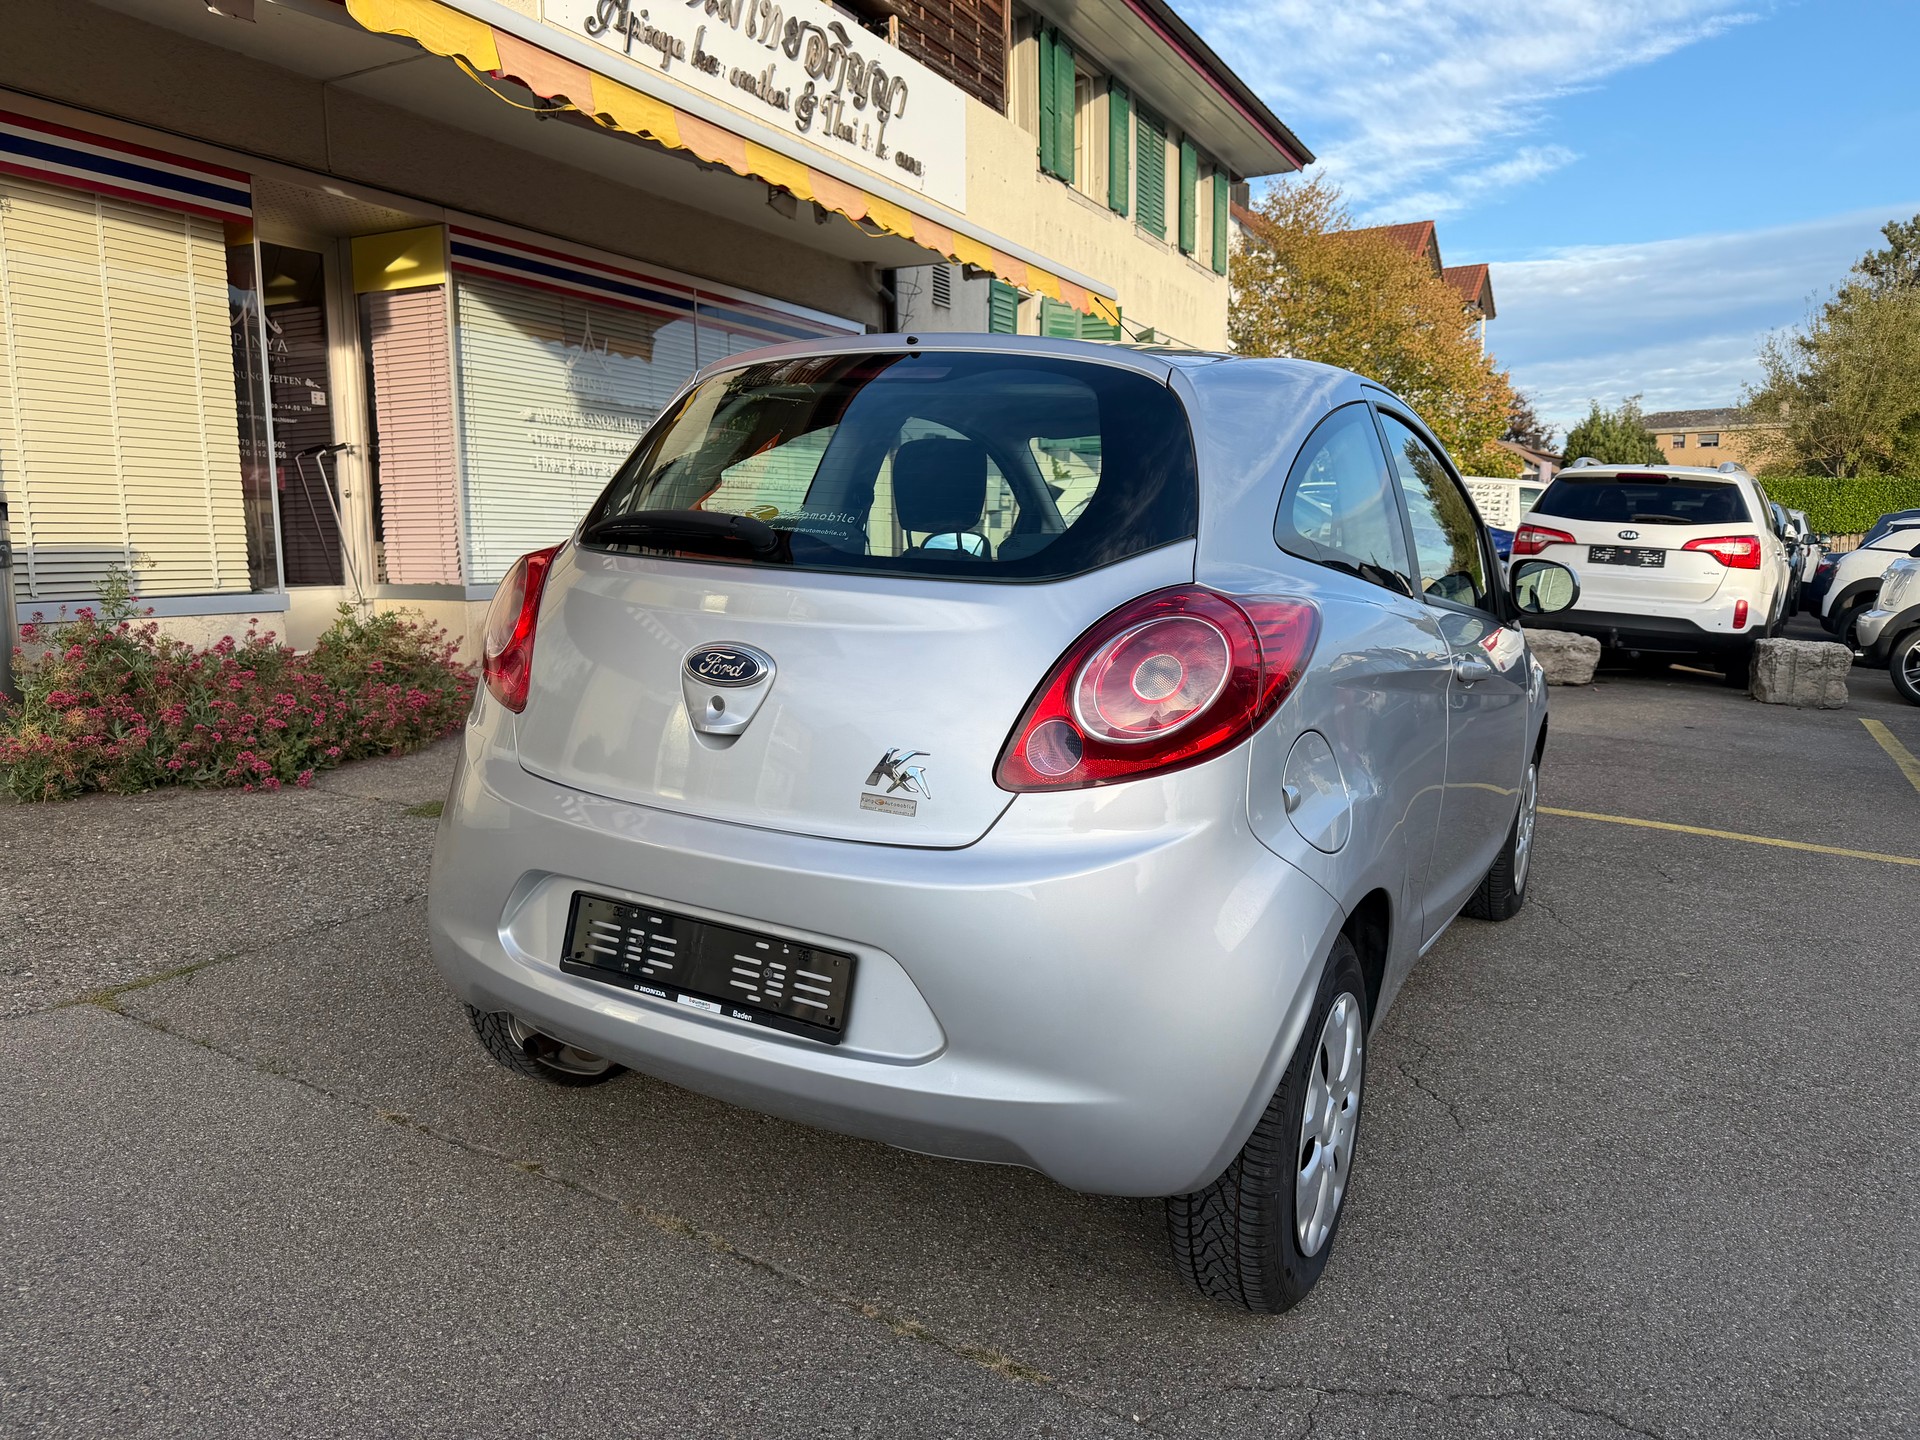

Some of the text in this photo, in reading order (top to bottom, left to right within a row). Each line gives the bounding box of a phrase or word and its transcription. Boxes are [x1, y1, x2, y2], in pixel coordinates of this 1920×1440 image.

[1620, 531, 1637, 539] KIA
[699, 652, 744, 677] Ford
[639, 985, 667, 998] HONDA
[732, 1009, 753, 1022] Baden
